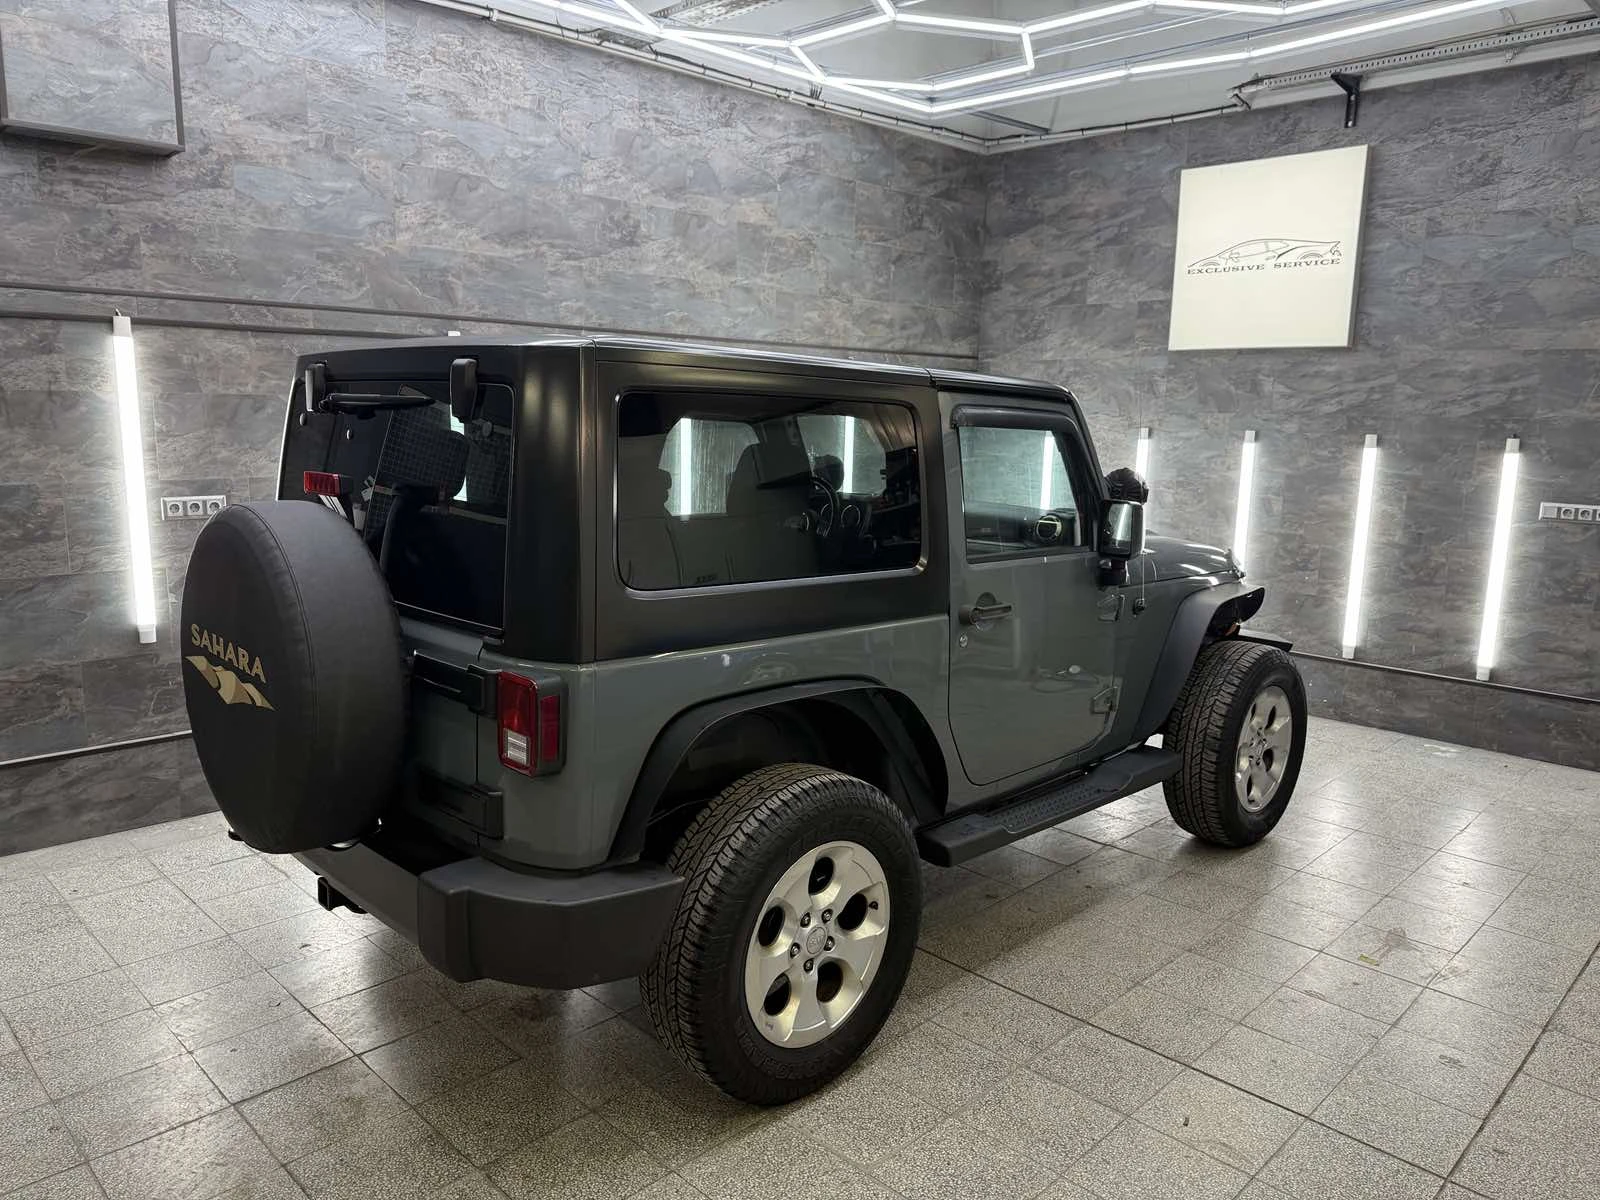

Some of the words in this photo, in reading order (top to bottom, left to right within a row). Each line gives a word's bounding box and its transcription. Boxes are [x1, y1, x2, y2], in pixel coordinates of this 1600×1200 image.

[1187, 264, 1265, 275] EXCLUSIVE
[1273, 258, 1341, 270] SERVICE
[191, 623, 266, 684] SAHARA
